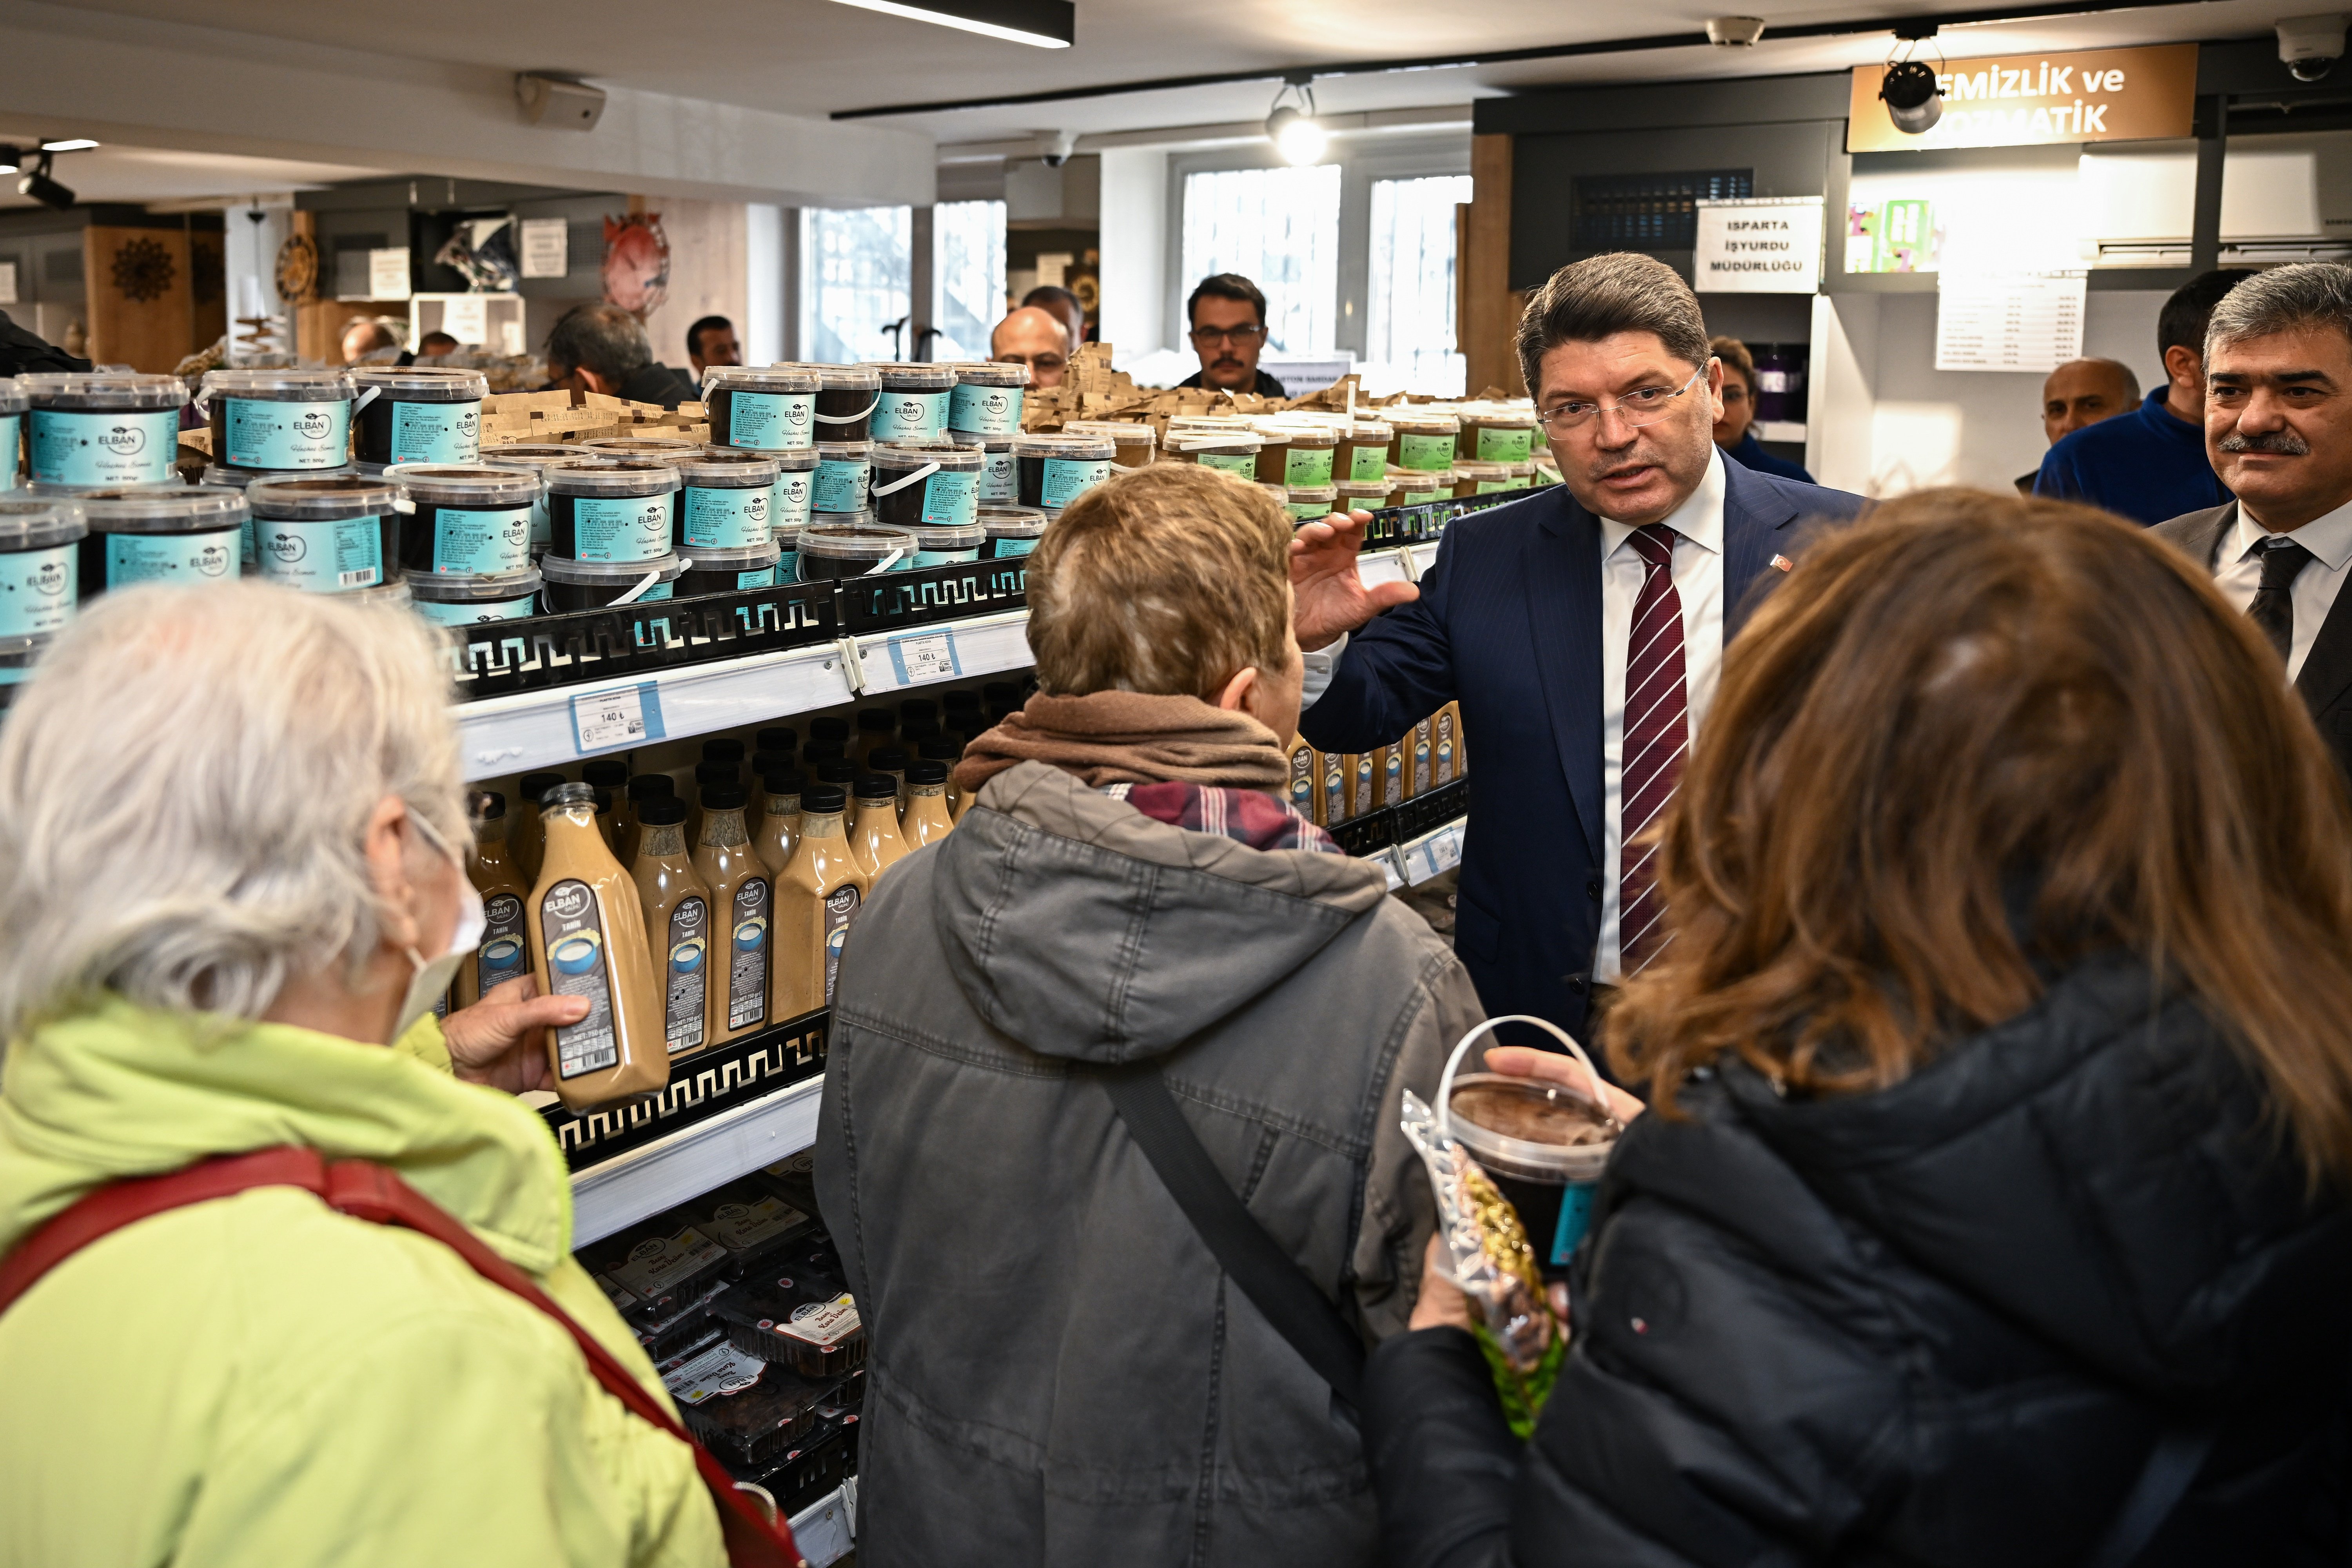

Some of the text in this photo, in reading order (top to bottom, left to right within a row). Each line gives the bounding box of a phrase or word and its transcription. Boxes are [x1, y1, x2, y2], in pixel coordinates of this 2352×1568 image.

[1935, 61, 2074, 102] EMİZLİK
[2082, 69, 2125, 93] ve
[1728, 221, 1789, 230] ISPARTA
[1726, 240, 1789, 252] İŞYURDU
[457, 420, 475, 429] ELBAN
[98, 436, 135, 445] ELBAN
[744, 505, 764, 513] ELBAN
[638, 514, 661, 524] ELBAN
[503, 528, 525, 538] ELBAN
[267, 542, 296, 552] ELBAN
[918, 653, 930, 662] 140
[602, 712, 617, 722] 140
[1293, 755, 1307, 763] ELBAN
[737, 889, 759, 901] ELBAN
[545, 893, 581, 912] ELBAN
[828, 895, 849, 908] ELBAN
[483, 906, 510, 918] ELBAN
[674, 909, 698, 921] ELBAN
[744, 909, 756, 917] TAHİN
[835, 915, 847, 924] TAHİN
[493, 926, 508, 935] TAHİN
[682, 929, 695, 938] TAHİN
[717, 1207, 741, 1220] ELBAN
[631, 1243, 657, 1262] ELBAN
[648, 1253, 666, 1265] Besni
[648, 1252, 684, 1274] Kuru Üzüm
[794, 1305, 818, 1321] ELBAN
[815, 1311, 831, 1321] Besni
[818, 1308, 848, 1328] Kuru Üzüm
[699, 1361, 735, 1383] Kuru Üzüm
[718, 1370, 736, 1379] Besni
[728, 1374, 755, 1387] ELBAN
